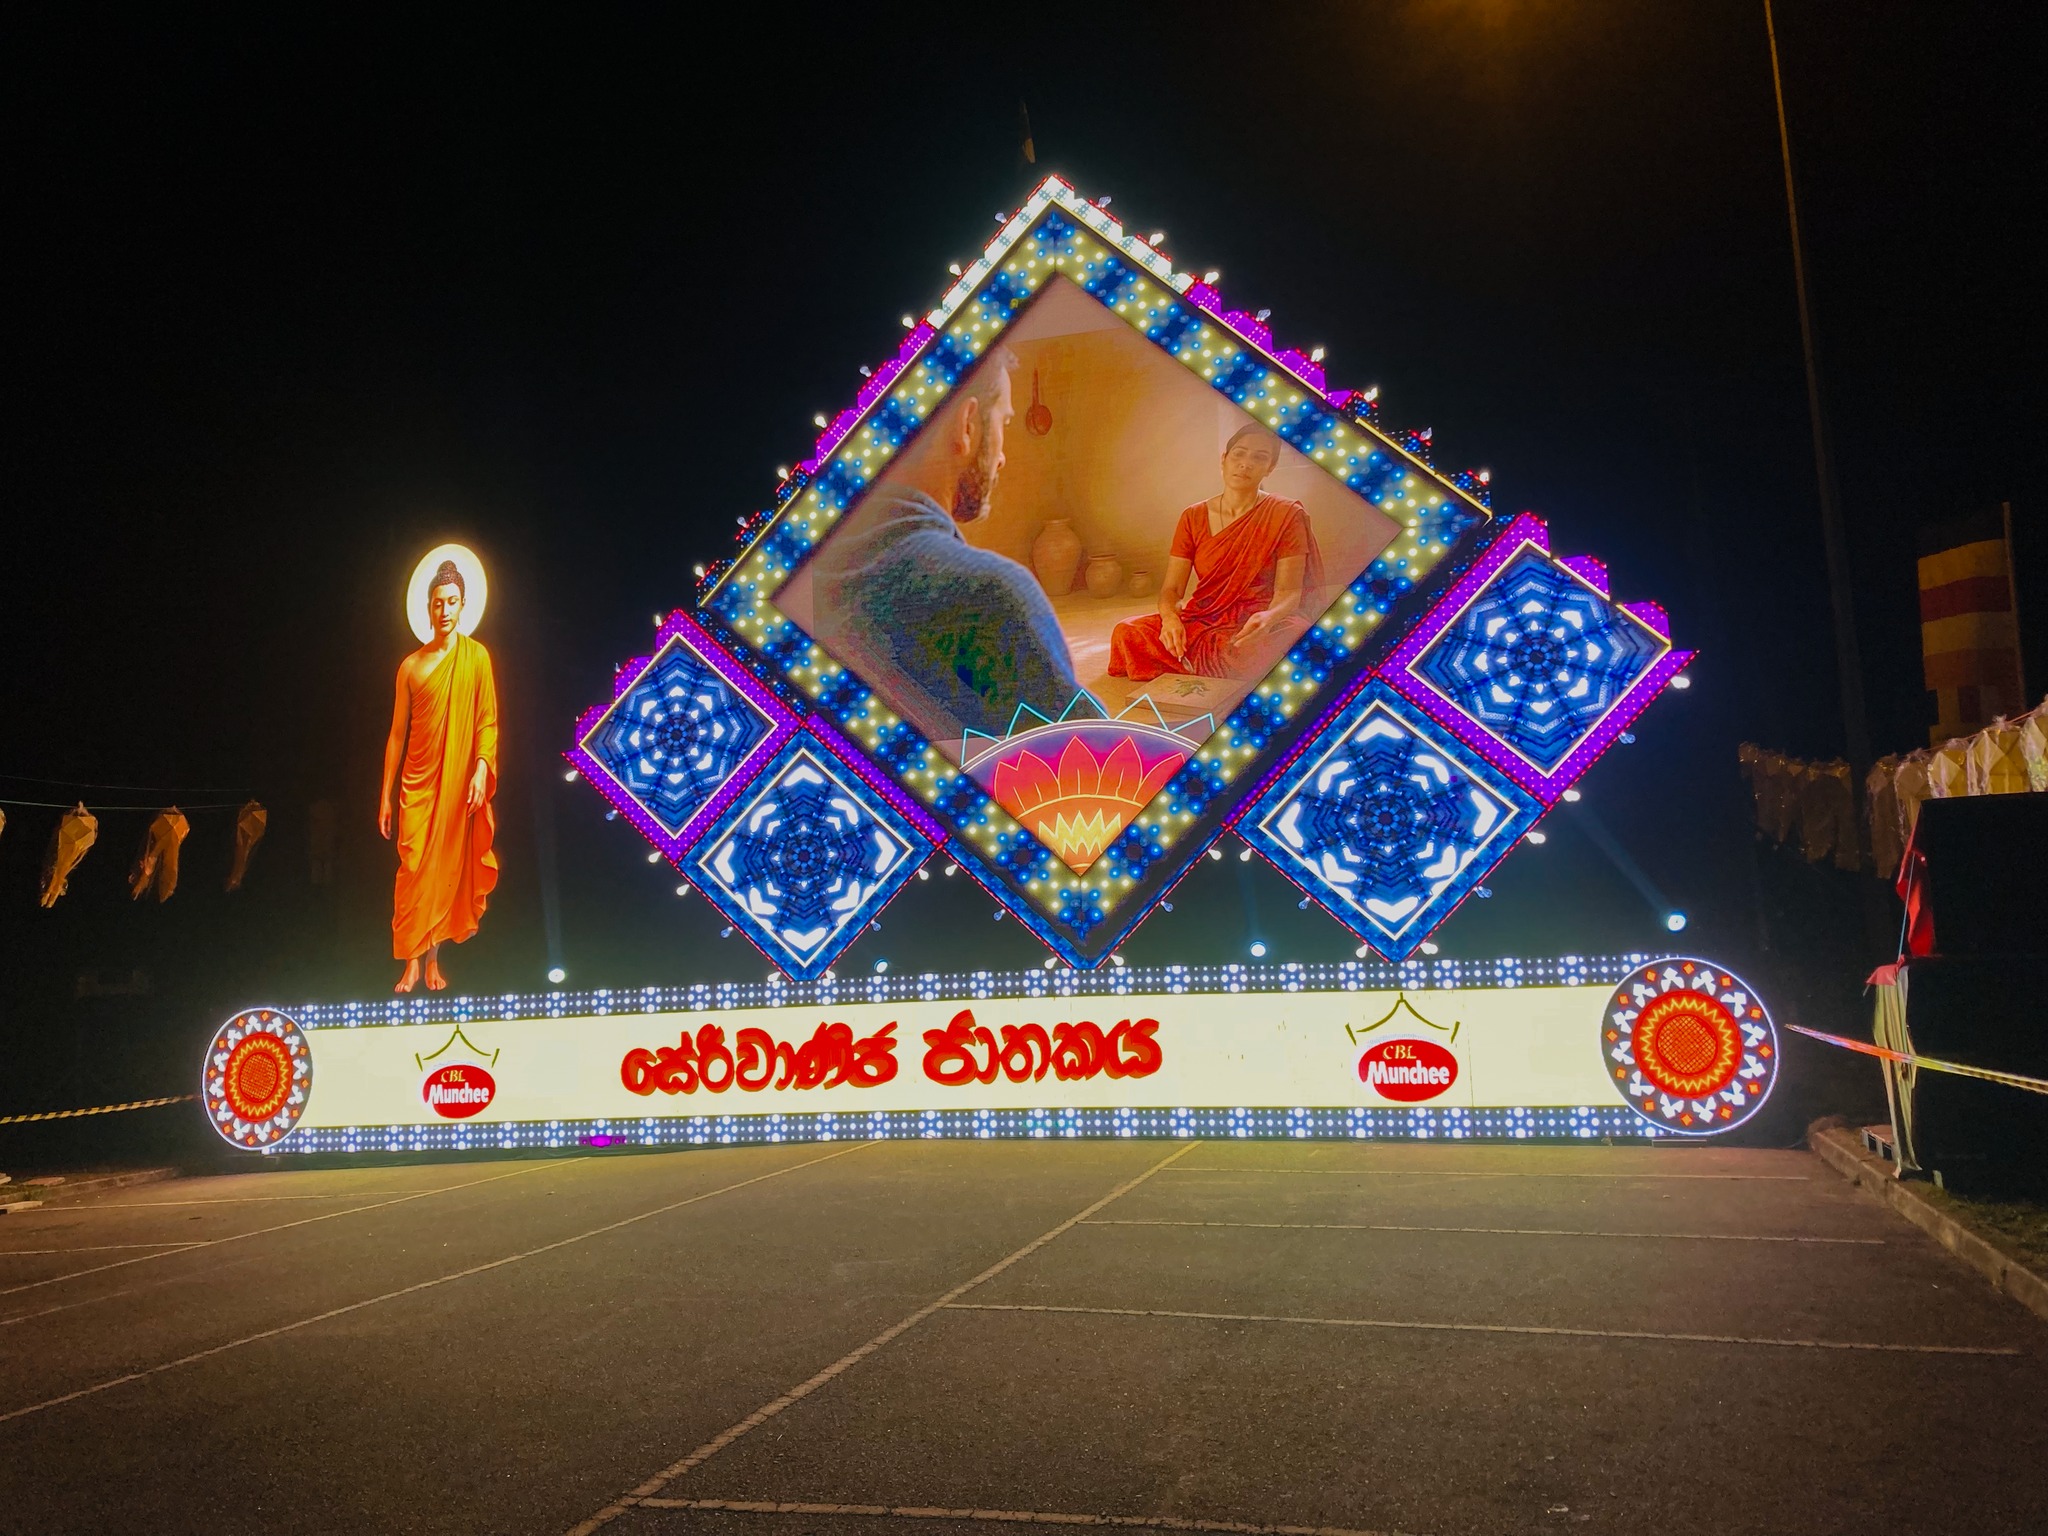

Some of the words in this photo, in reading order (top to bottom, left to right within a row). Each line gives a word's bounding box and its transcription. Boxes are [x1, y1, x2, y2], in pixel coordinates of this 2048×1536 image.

[922, 1008, 1163, 1087] ජාතකය
[1382, 1045, 1417, 1060] CBL
[440, 1070, 466, 1083] CBL
[1367, 1060, 1450, 1084] Munchee
[429, 1082, 489, 1104] Munchee
